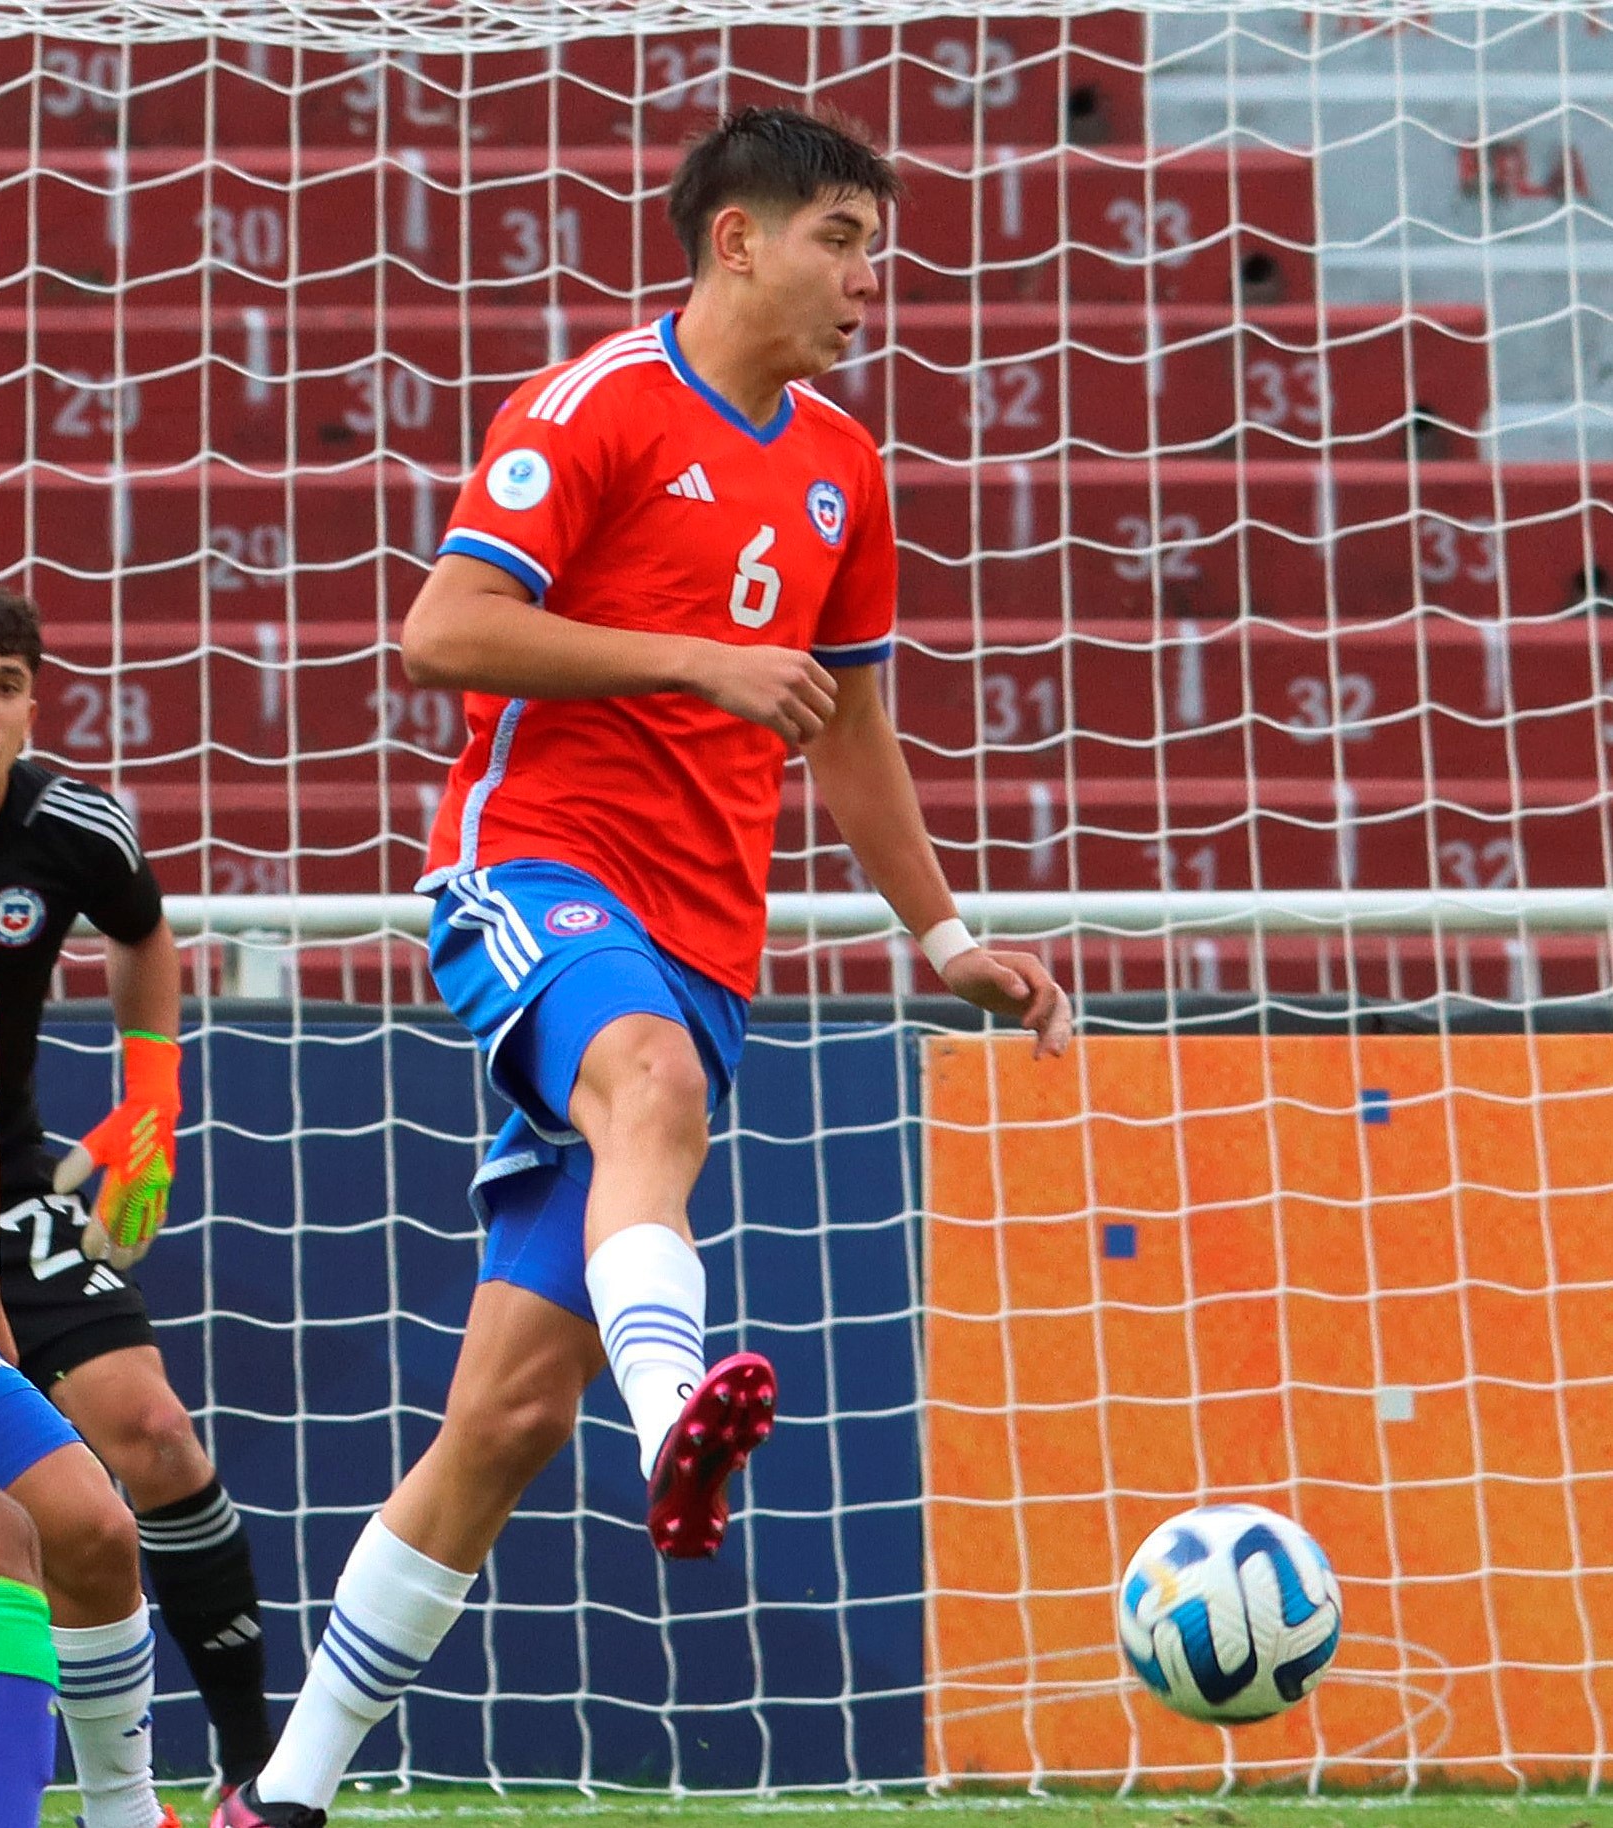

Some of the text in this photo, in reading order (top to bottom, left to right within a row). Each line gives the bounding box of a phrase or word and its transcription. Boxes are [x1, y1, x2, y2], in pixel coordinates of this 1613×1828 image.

[44, 50, 125, 116] 30
[647, 45, 722, 110] 32
[932, 40, 1019, 106] 33
[195, 206, 282, 266] 30
[499, 208, 581, 274] 31
[1105, 202, 1192, 266] 33
[54, 372, 141, 436] 29
[343, 368, 432, 432] 30
[961, 366, 1042, 430] 32
[1246, 362, 1333, 424] 33
[207, 526, 287, 590] 29
[728, 525, 782, 629] 6
[1114, 516, 1201, 579] 32
[1419, 517, 1497, 580] 33
[63, 684, 151, 748] 28
[367, 690, 457, 750] 29
[983, 675, 1056, 743] 31
[1289, 676, 1377, 741] 32
